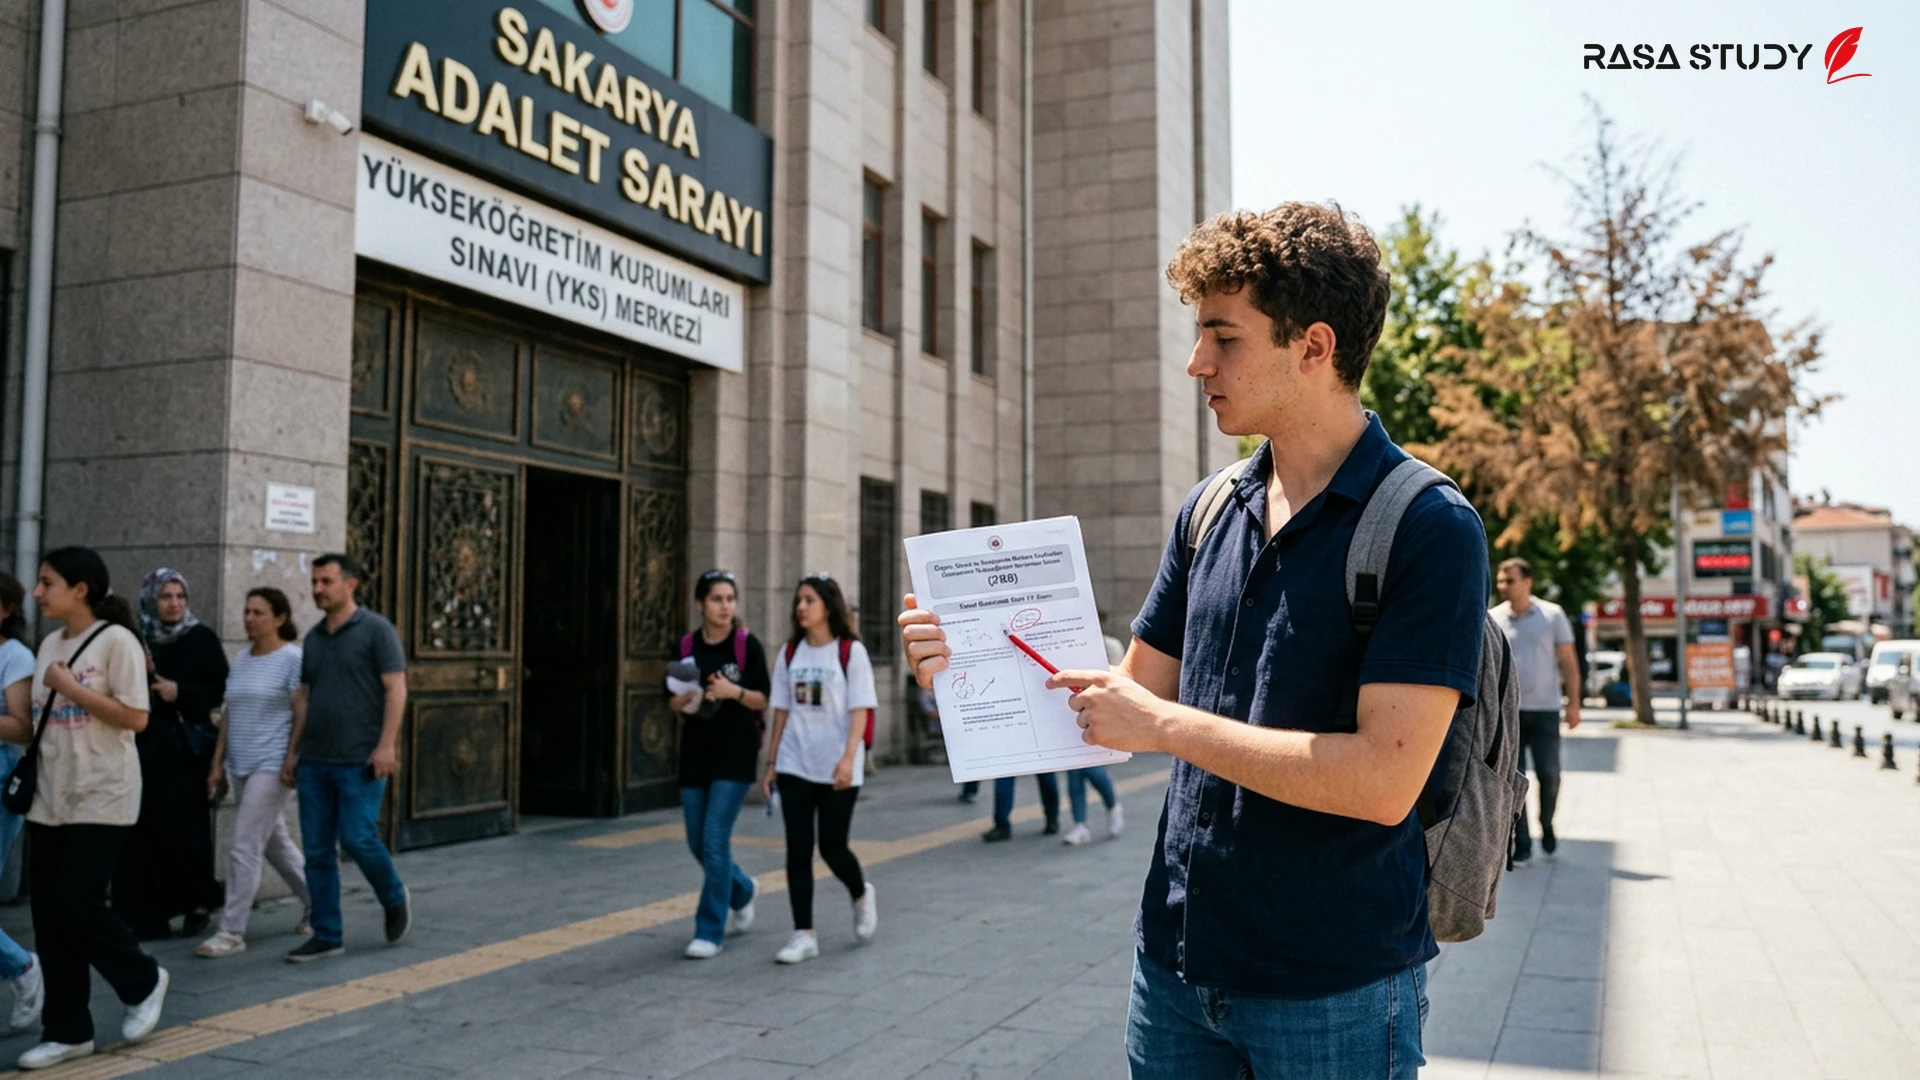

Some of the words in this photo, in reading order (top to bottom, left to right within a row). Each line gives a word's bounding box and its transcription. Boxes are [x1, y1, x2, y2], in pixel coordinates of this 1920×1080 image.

[394, 41, 610, 184] ADALET
[621, 148, 763, 257] SARAYI
[496, 7, 700, 159] SAKARYA
[362, 154, 602, 272] YÜKSEKÖĞRETİM
[610, 251, 730, 320] KURUMLARI
[450, 237, 537, 292] SINAVI
[546, 269, 609, 321] (YKS)
[616, 294, 702, 346] MERKEZİ
